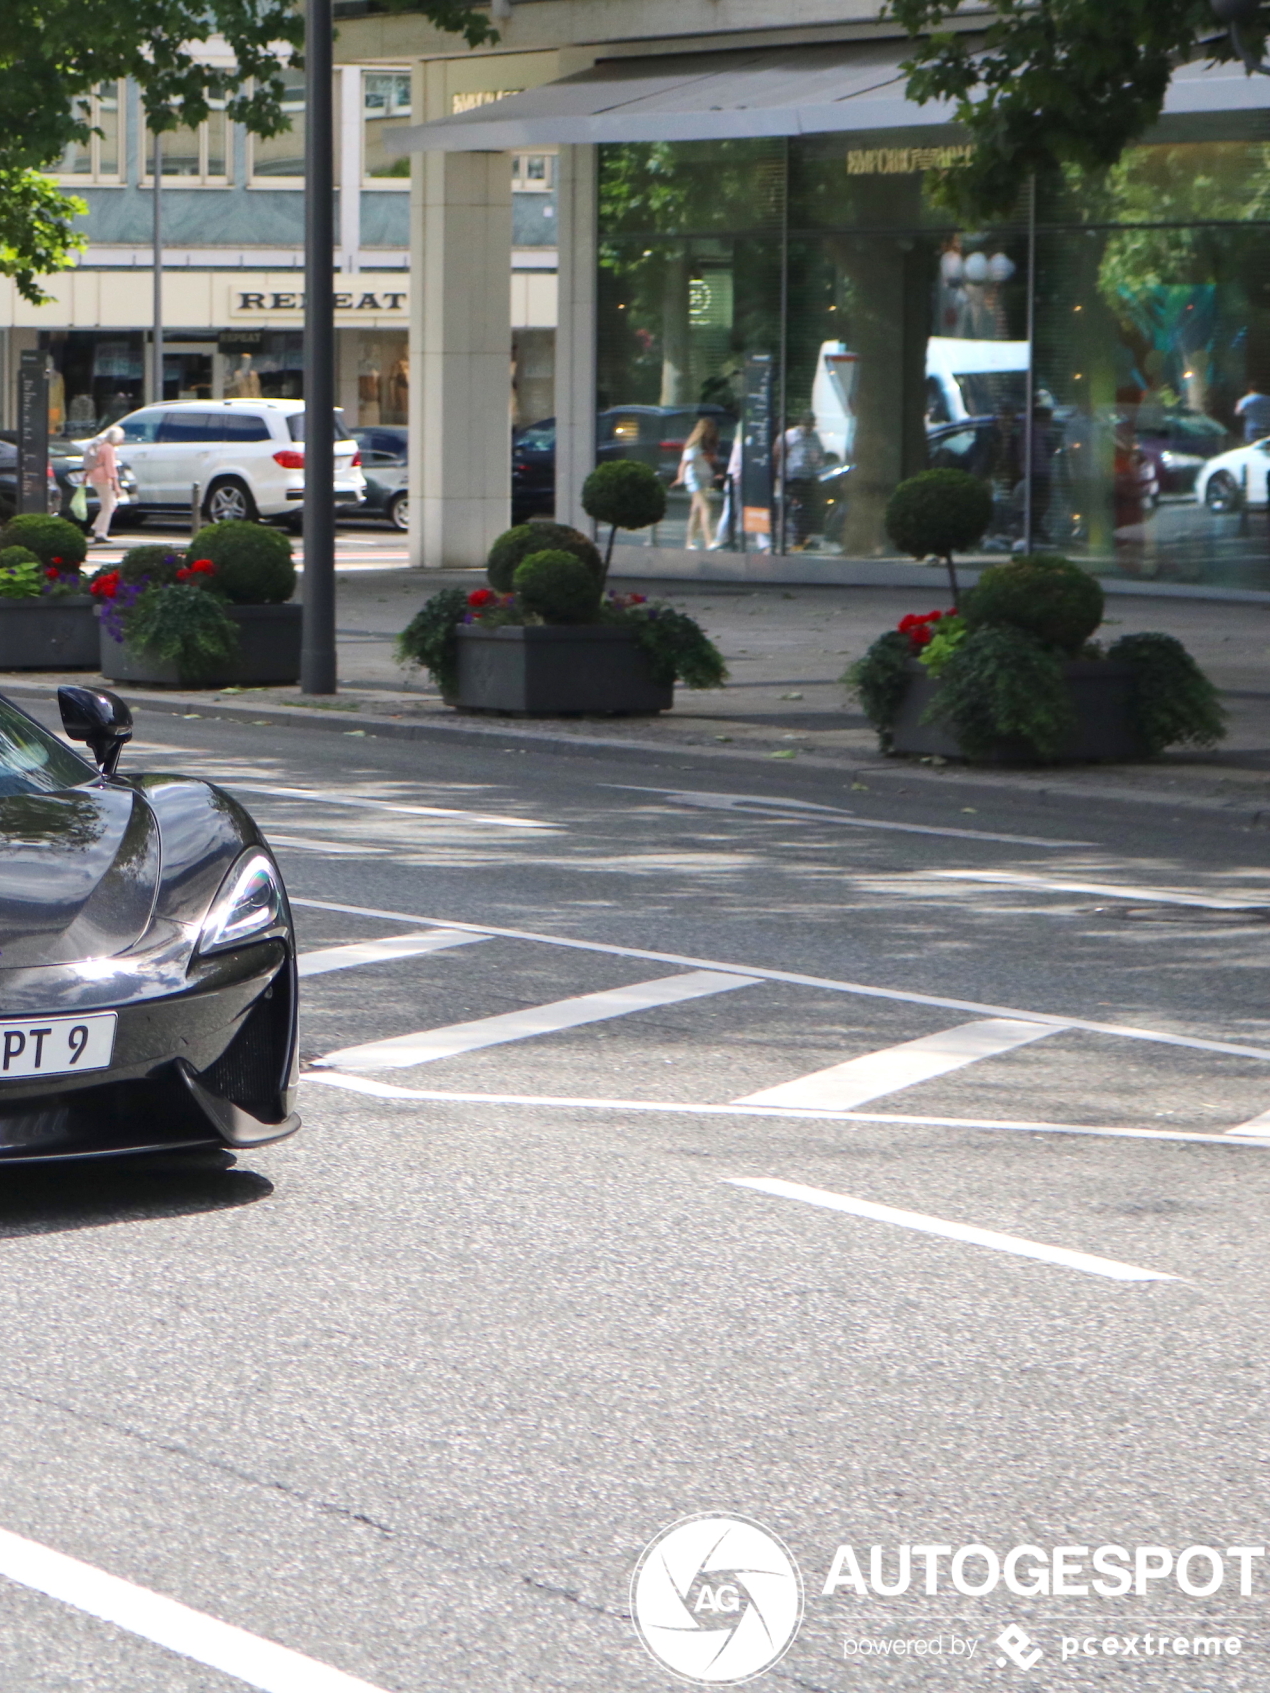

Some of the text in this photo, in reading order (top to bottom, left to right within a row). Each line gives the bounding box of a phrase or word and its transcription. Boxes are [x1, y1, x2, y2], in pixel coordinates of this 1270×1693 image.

[237, 292, 407, 310] REEAT
[3, 1028, 52, 1071] PT
[68, 1025, 89, 1065] 9
